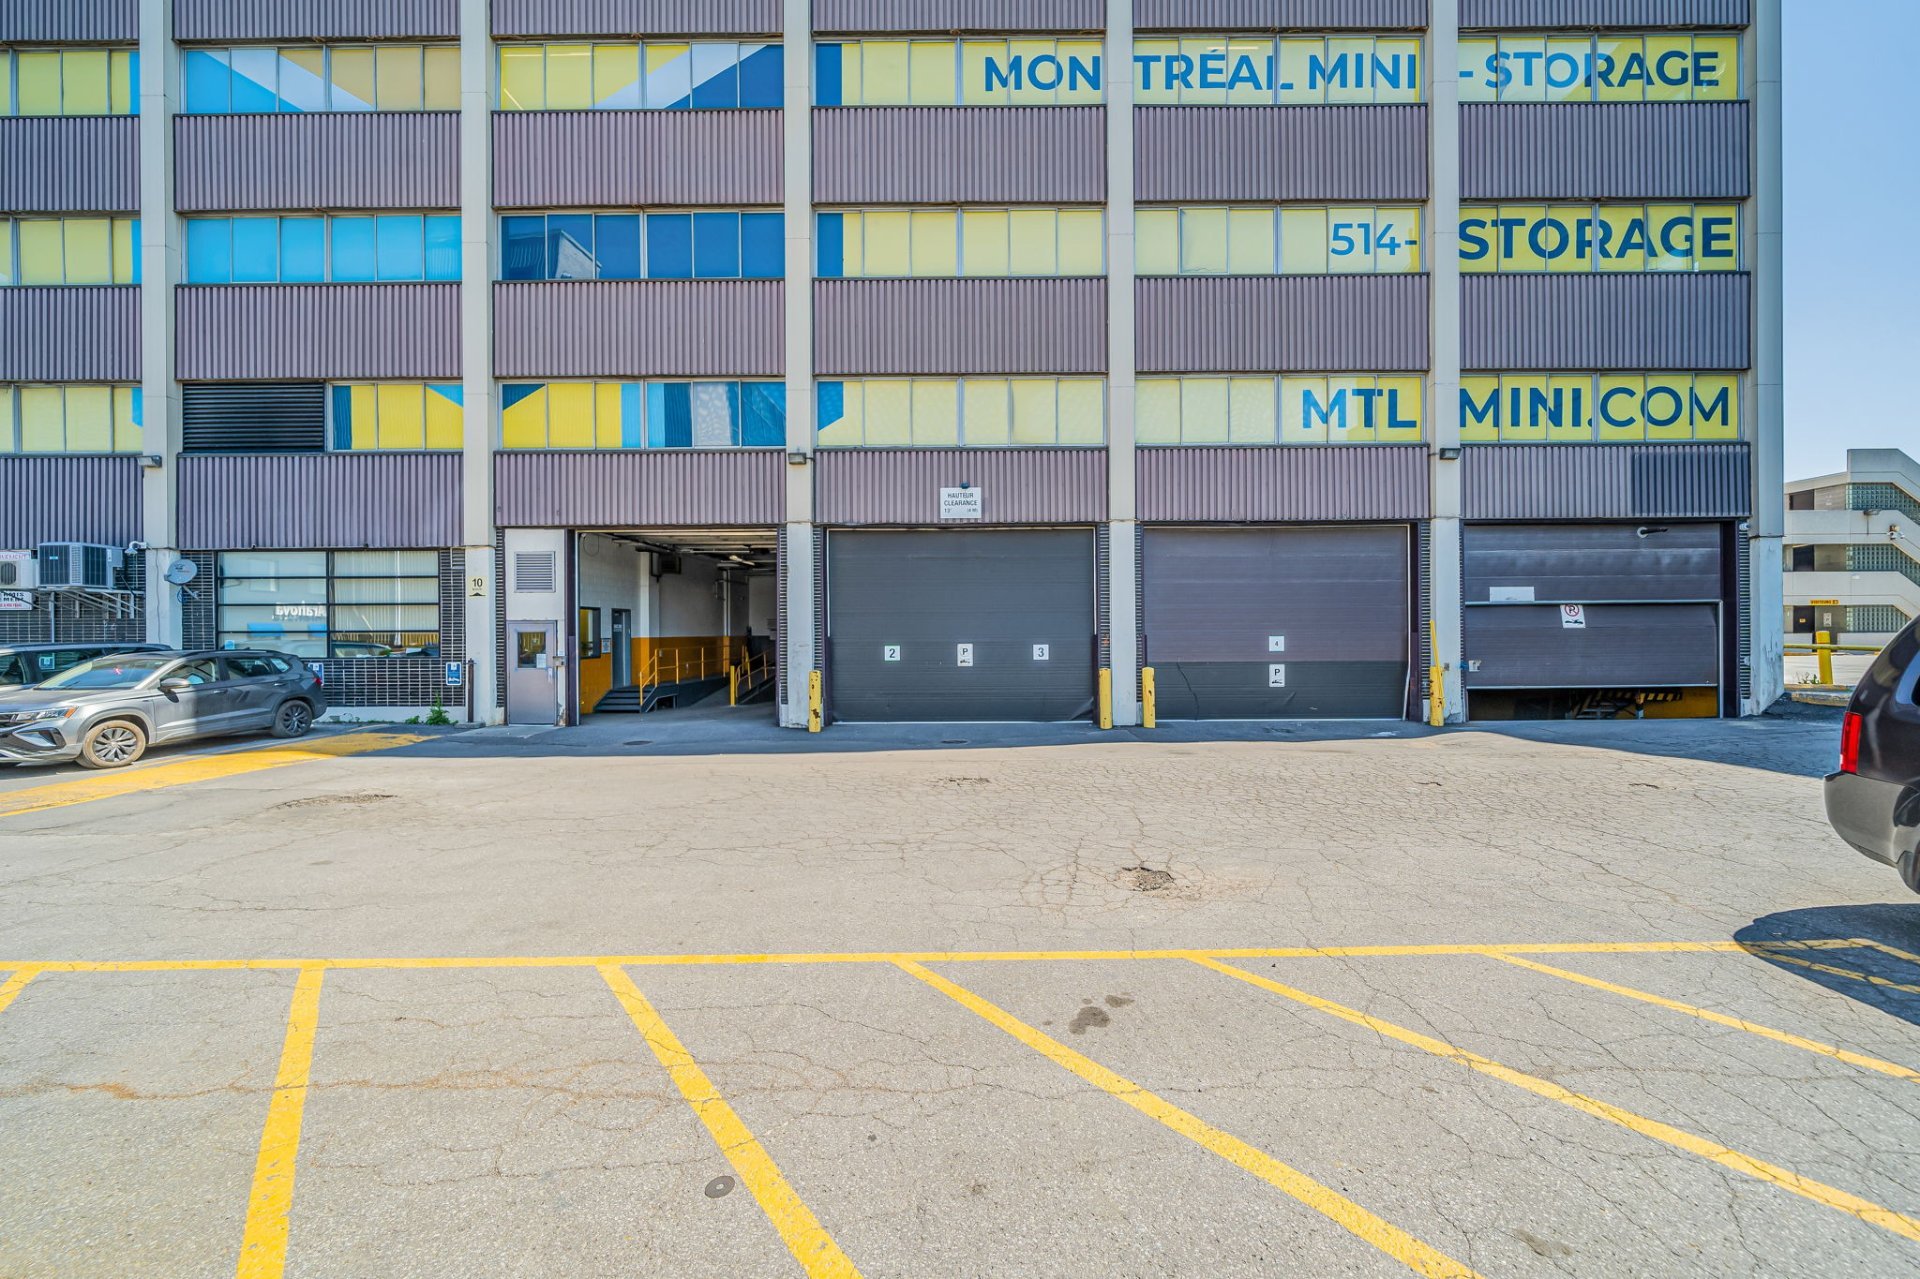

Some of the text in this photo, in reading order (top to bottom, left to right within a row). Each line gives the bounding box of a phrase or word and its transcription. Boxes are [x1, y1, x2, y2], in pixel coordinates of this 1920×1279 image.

[1308, 53, 1416, 89] MINI
[1459, 217, 1733, 260] STORAGE
[1302, 386, 1729, 429] MTL MINI.COM
[472, 578, 483, 587] 10
[889, 648, 896, 658] 2
[1038, 647, 1045, 657] 3
